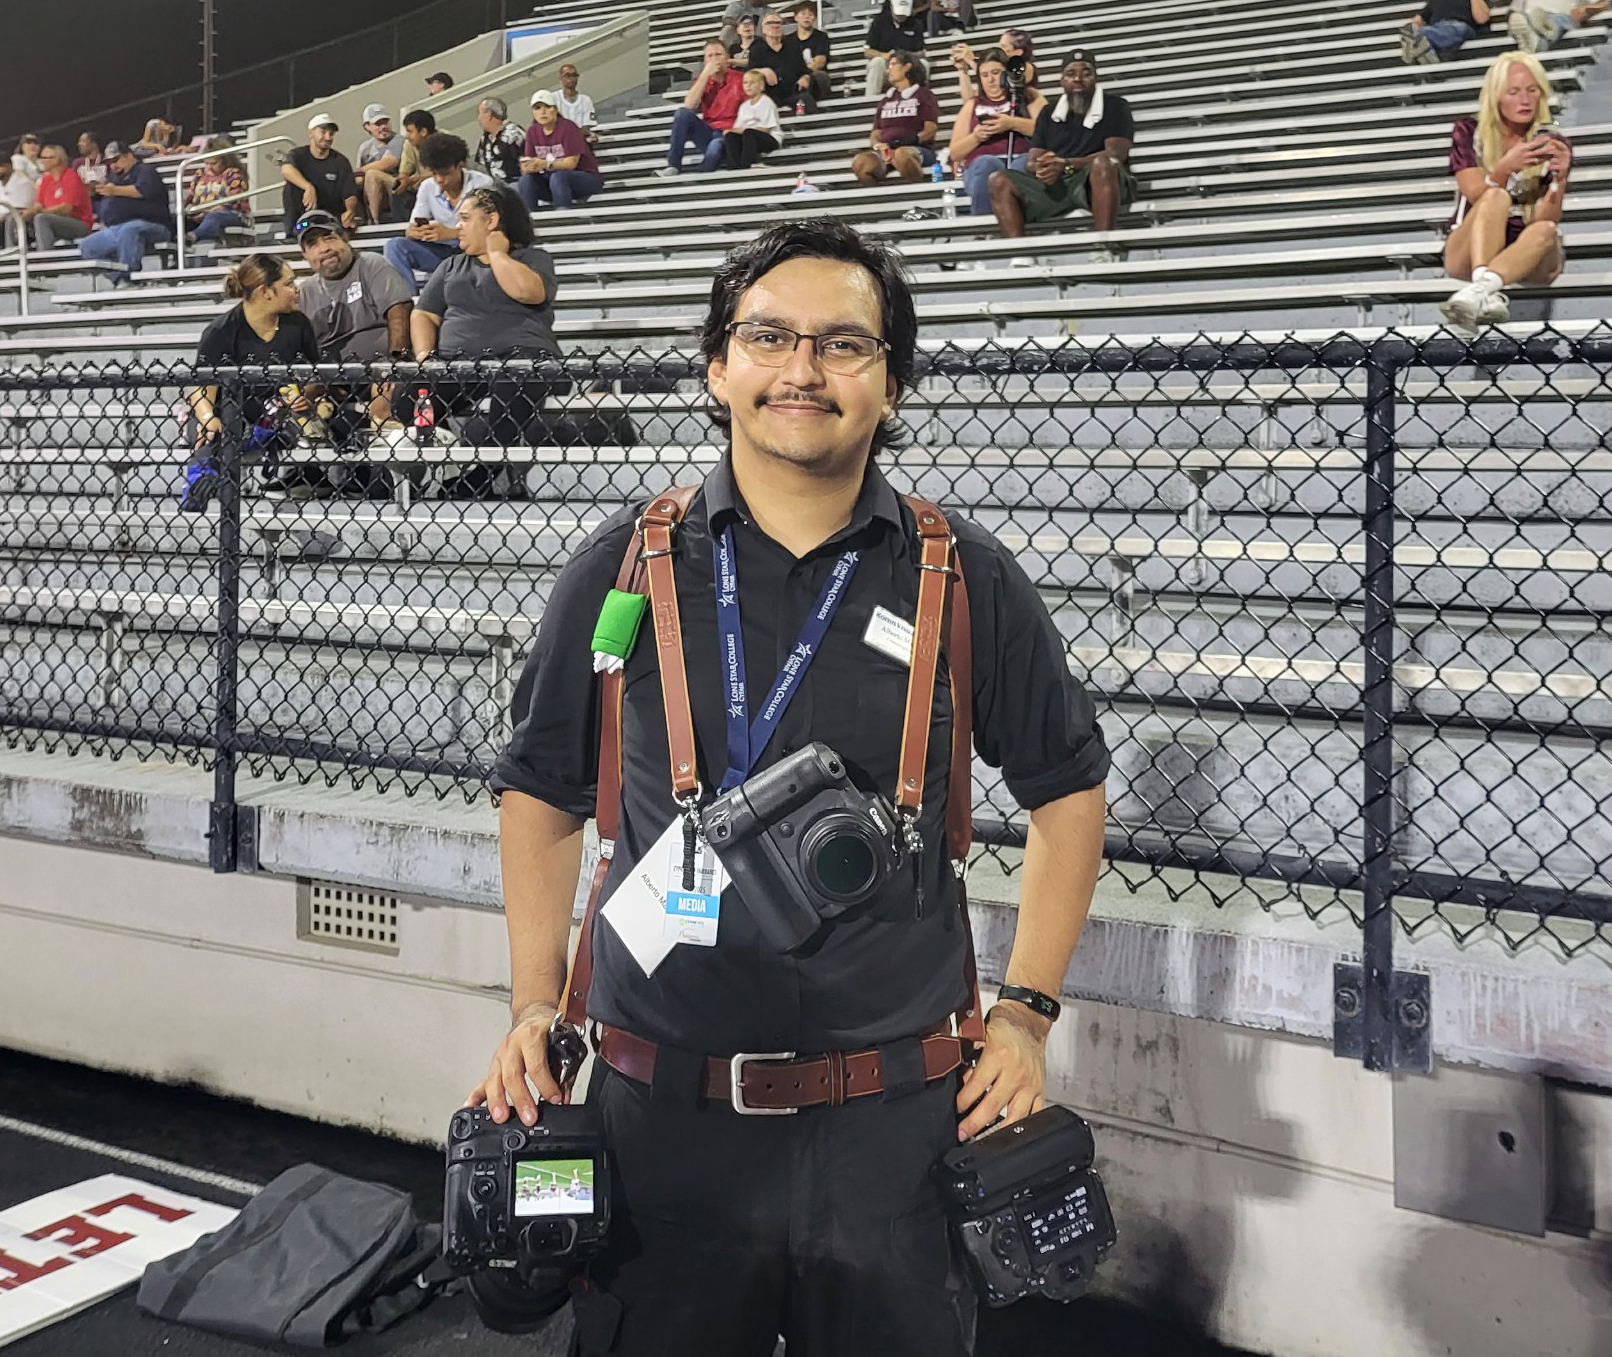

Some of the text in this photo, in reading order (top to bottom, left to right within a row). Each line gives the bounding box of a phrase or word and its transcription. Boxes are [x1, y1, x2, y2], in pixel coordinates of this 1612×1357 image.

[721, 560, 729, 576] STAR
[722, 576, 730, 593] LONE
[817, 563, 850, 620] LONE STAR COLLEGE
[726, 634, 739, 702] LONE STAR COLLEGE
[763, 657, 804, 721] LONE STAR COLLEGE
[869, 807, 888, 836] Canon
[641, 873, 660, 898] Alberto
[677, 897, 707, 914] MEDIA
